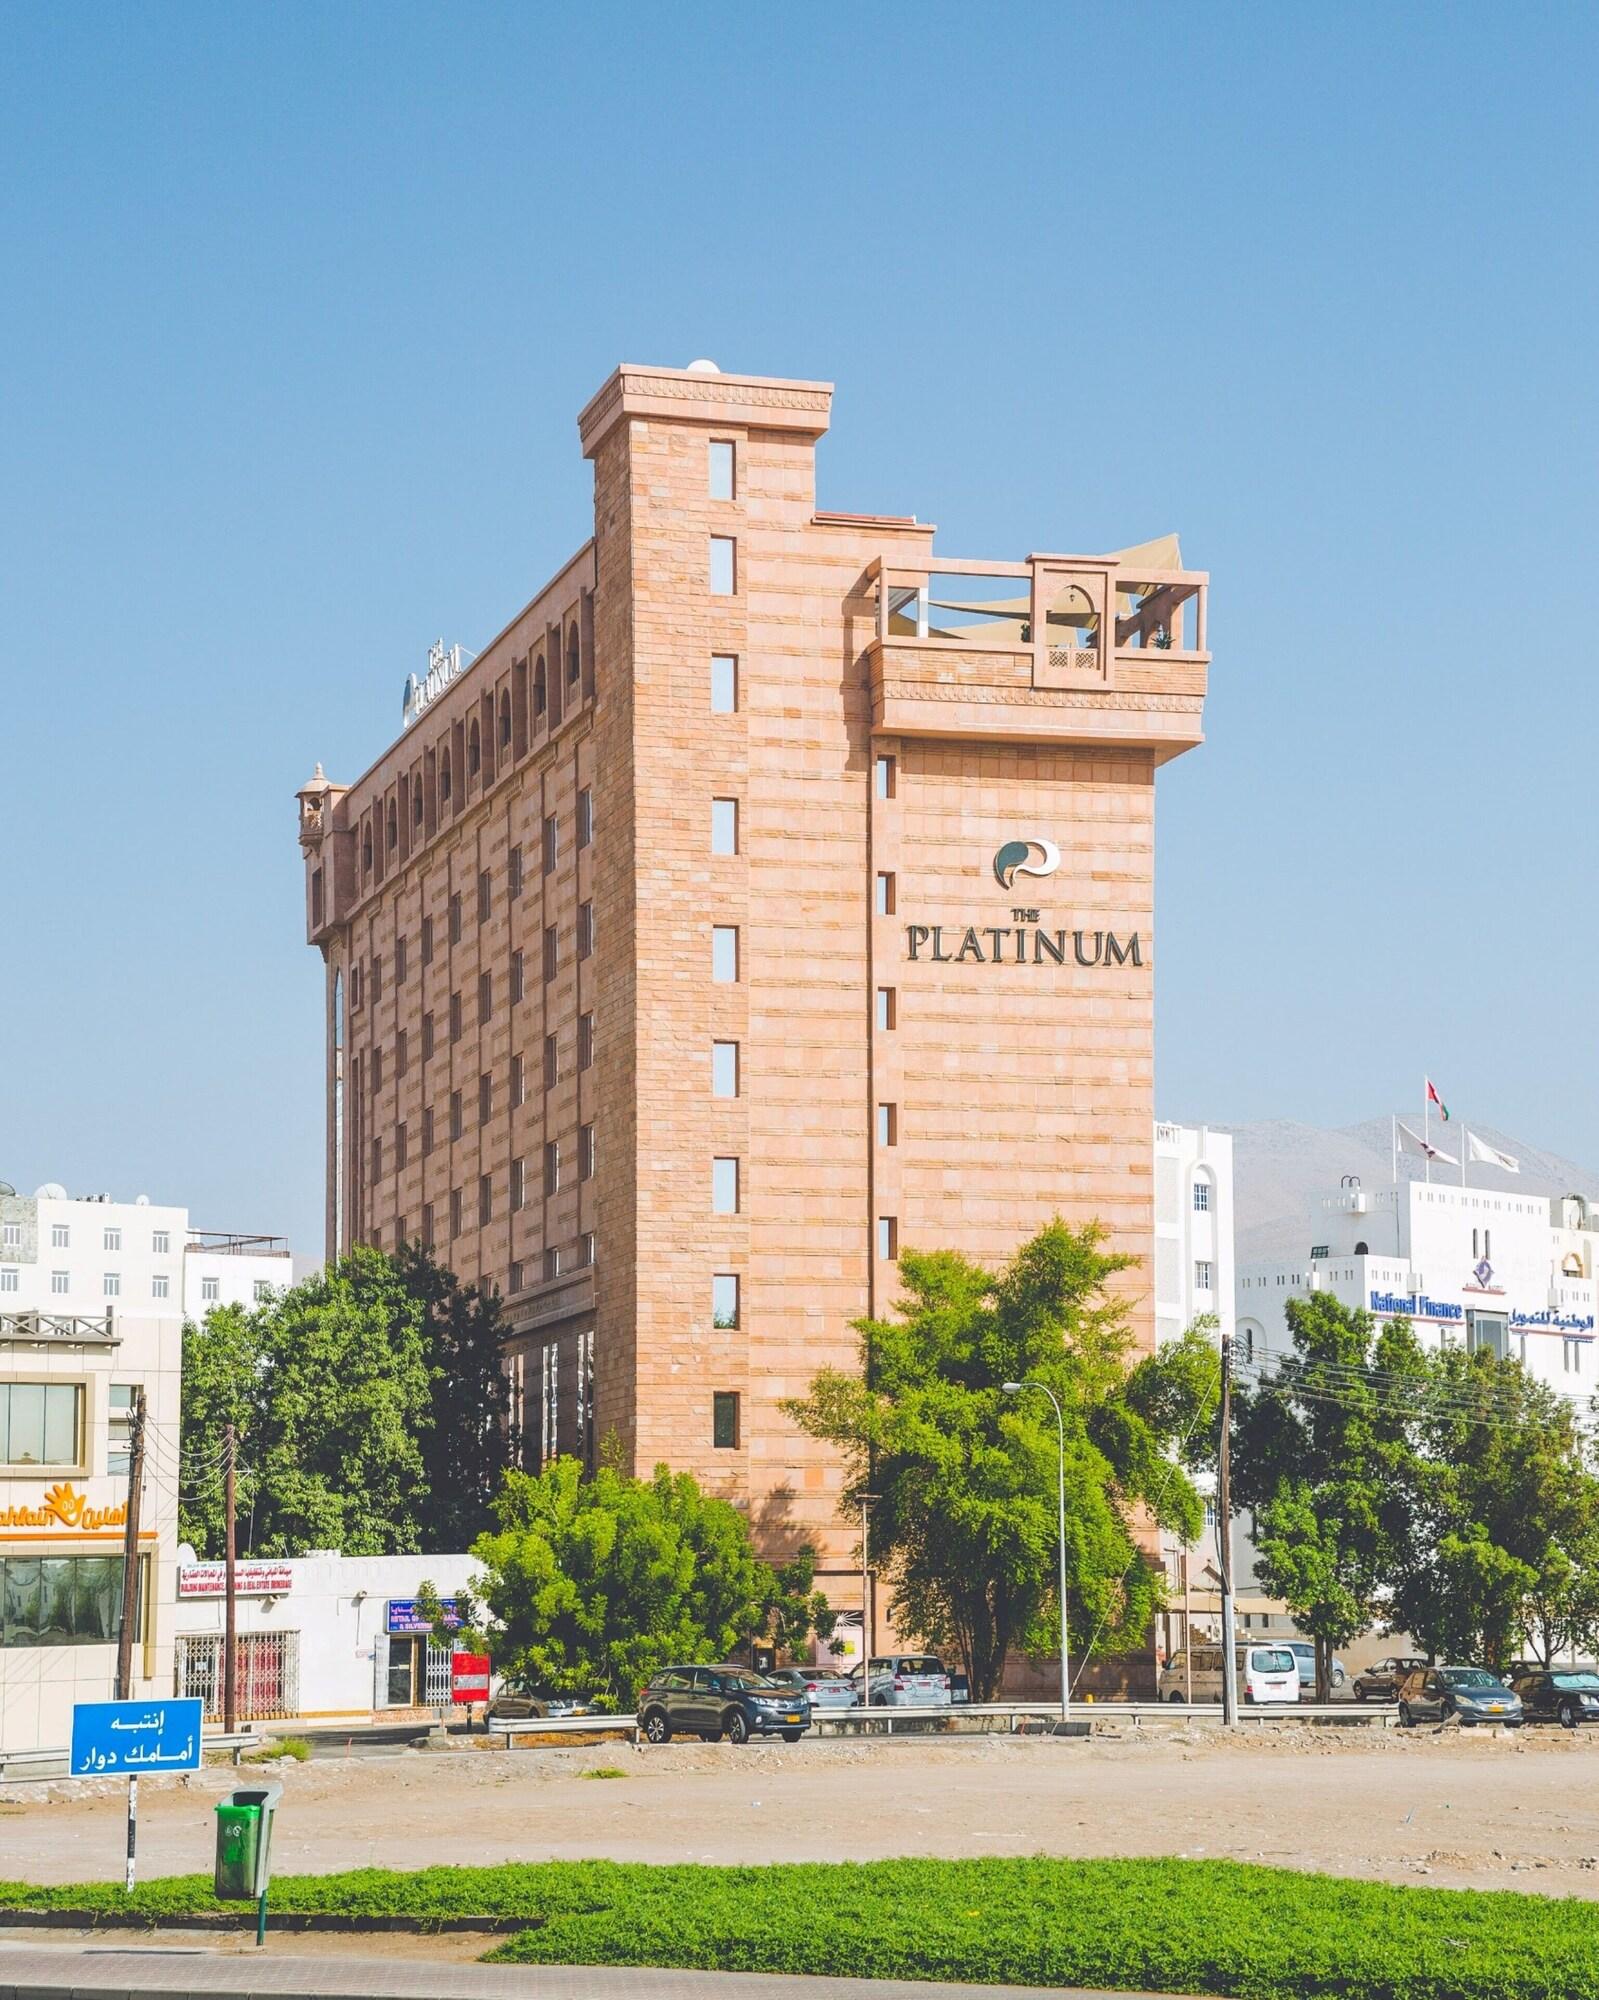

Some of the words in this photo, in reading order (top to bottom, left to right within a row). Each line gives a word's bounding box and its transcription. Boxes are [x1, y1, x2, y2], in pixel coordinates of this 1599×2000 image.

[1010, 908, 1040, 923] THE
[904, 925, 1143, 967] PLATINUM
[1370, 1291, 1417, 1314] National
[1419, 1296, 1463, 1319] Finance
[1509, 1308, 1551, 1327] للتمويل
[1553, 1310, 1594, 1332] الوطنية
[110, 1709, 165, 1735] إنتبه
[79, 1746, 118, 1771] دوار
[124, 1735, 193, 1764] أمامك
